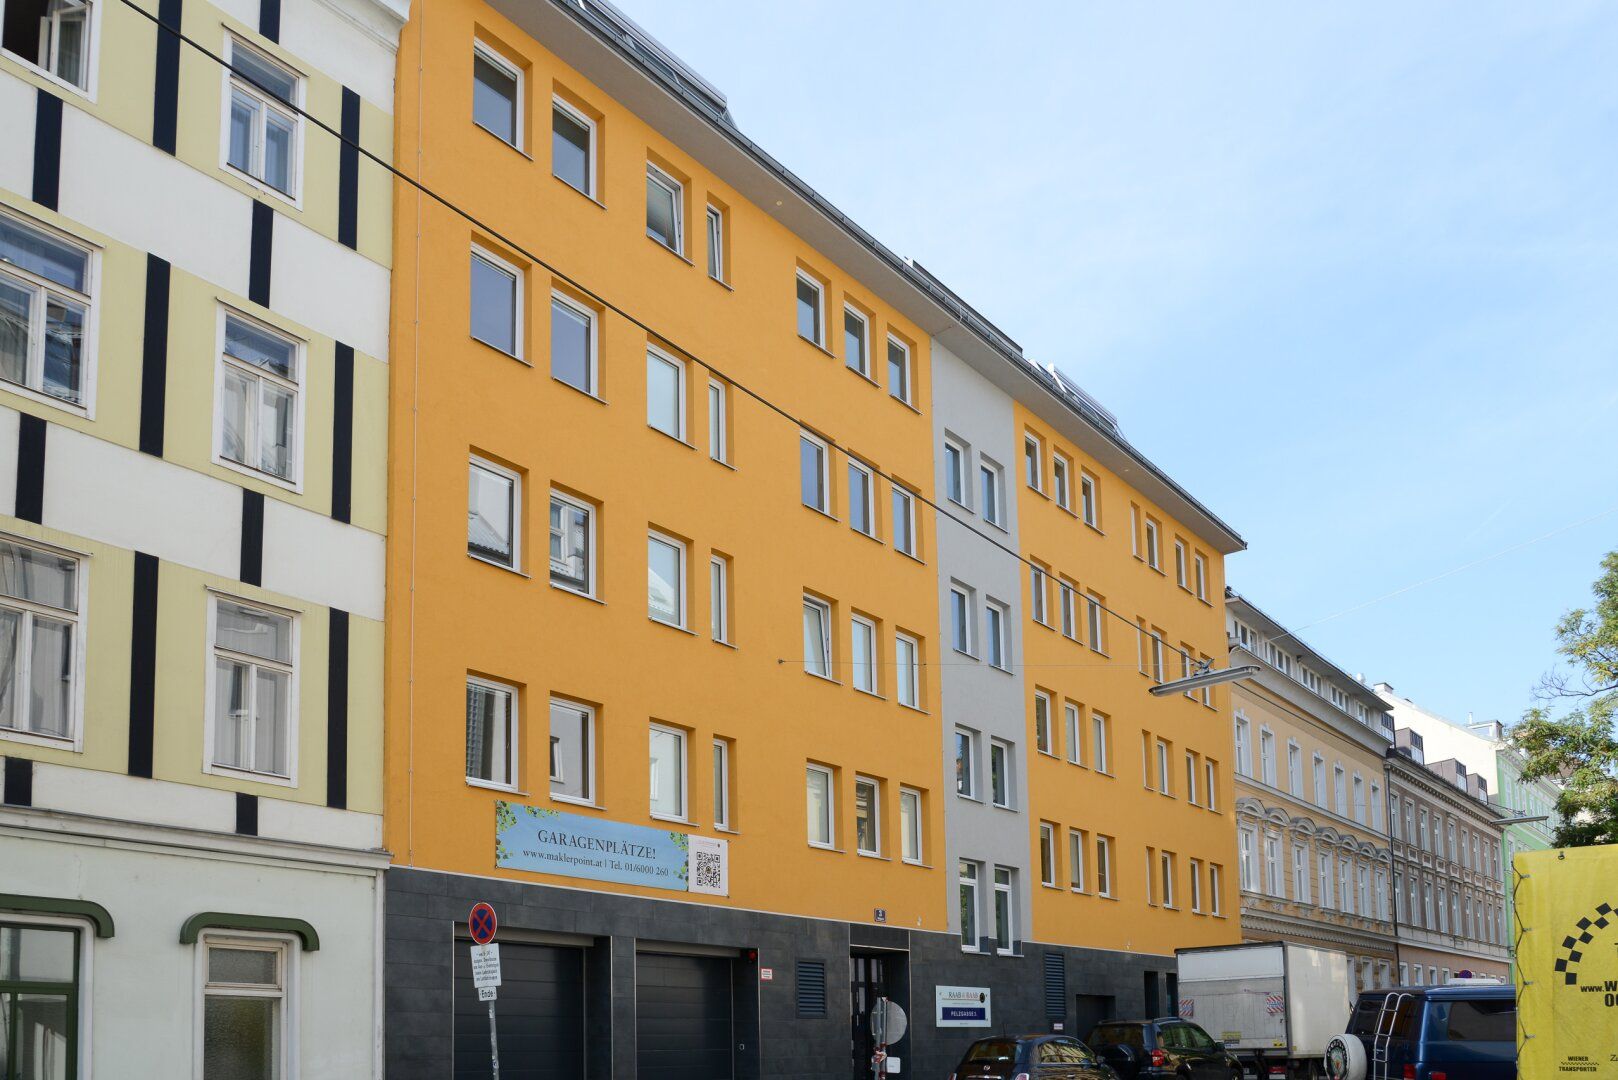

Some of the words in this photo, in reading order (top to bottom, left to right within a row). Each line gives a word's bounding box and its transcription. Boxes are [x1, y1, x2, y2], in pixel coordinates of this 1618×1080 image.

[538, 829, 656, 859] GARAGENPLÄTZE!
[522, 849, 602, 867] www.maklerpoint.at
[609, 860, 622, 870] Tel.
[624, 863, 654, 875] 01/6000
[656, 867, 669, 876] 260
[481, 989, 494, 998] Ende
